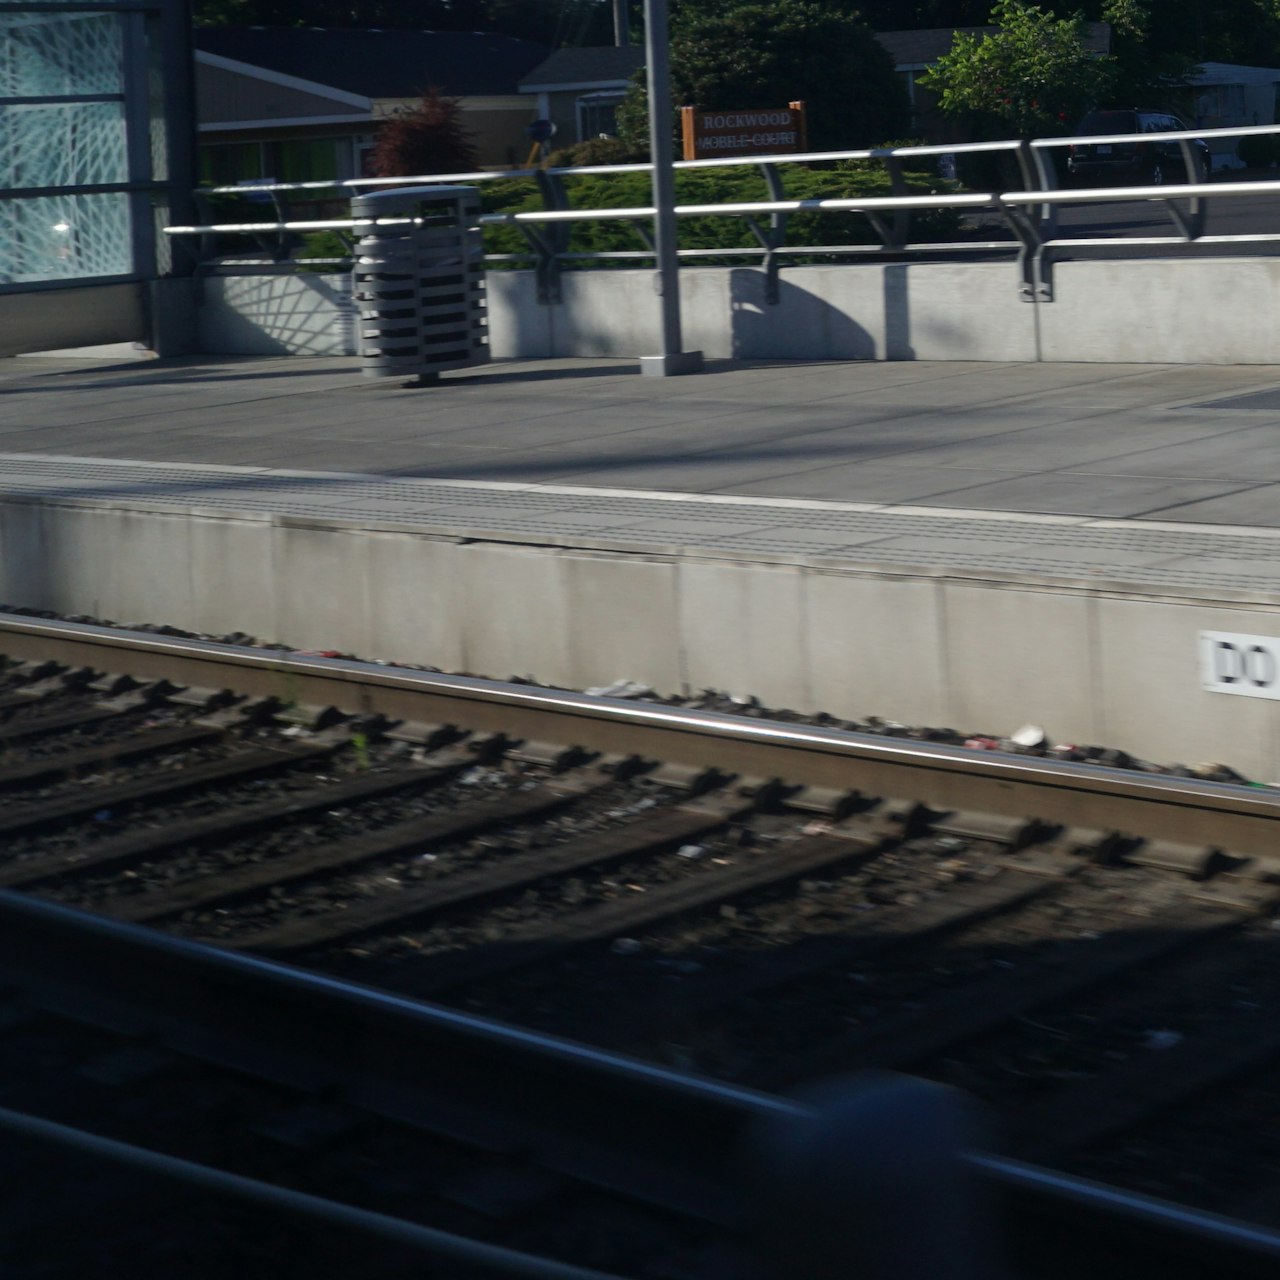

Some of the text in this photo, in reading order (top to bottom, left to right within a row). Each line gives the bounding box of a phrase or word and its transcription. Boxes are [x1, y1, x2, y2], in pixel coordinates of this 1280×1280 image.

[703, 112, 791, 129] ROCKWOOD
[696, 131, 798, 150] MOBILE COURT
[1213, 641, 1275, 686] DO
